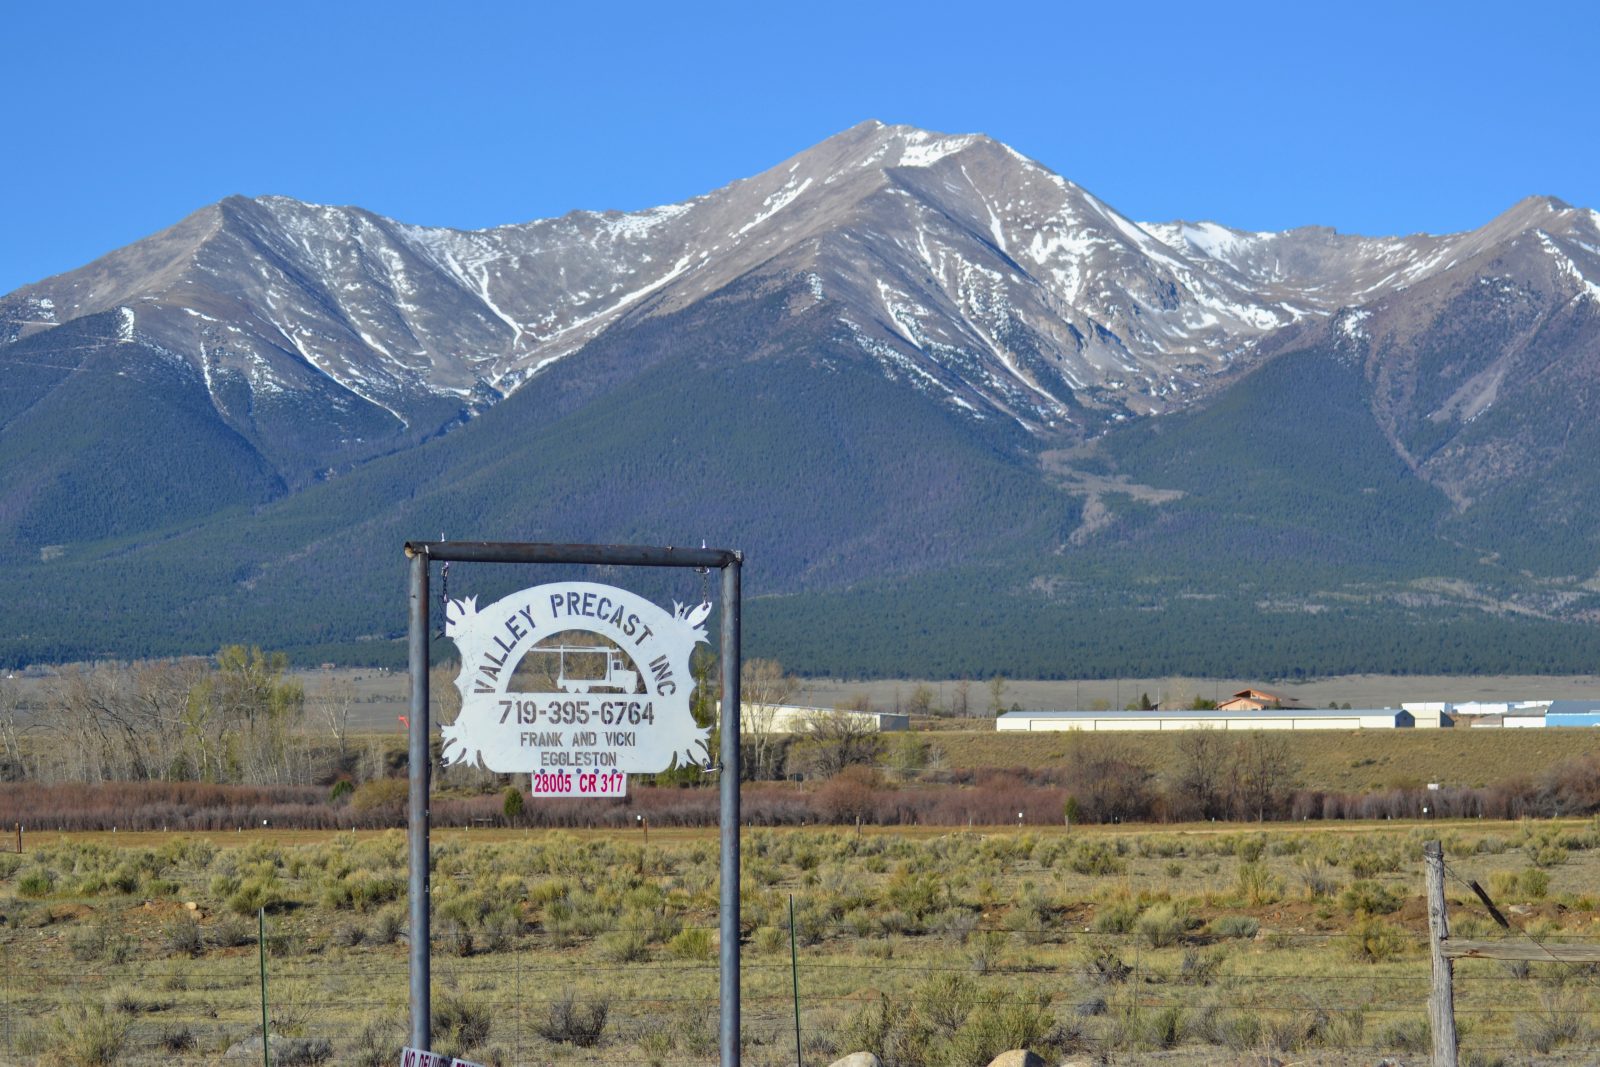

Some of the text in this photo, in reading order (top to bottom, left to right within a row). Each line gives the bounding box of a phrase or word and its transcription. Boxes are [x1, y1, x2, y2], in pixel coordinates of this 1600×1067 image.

[474, 592, 676, 697] VALLEY PRECAST INC
[498, 700, 655, 725] 719-395-6764
[520, 732, 636, 747] FRANK AND VICKI
[541, 752, 617, 767] EGGLESTON
[534, 774, 623, 793] 28005 CR 317
[403, 1050, 416, 1067] NO
